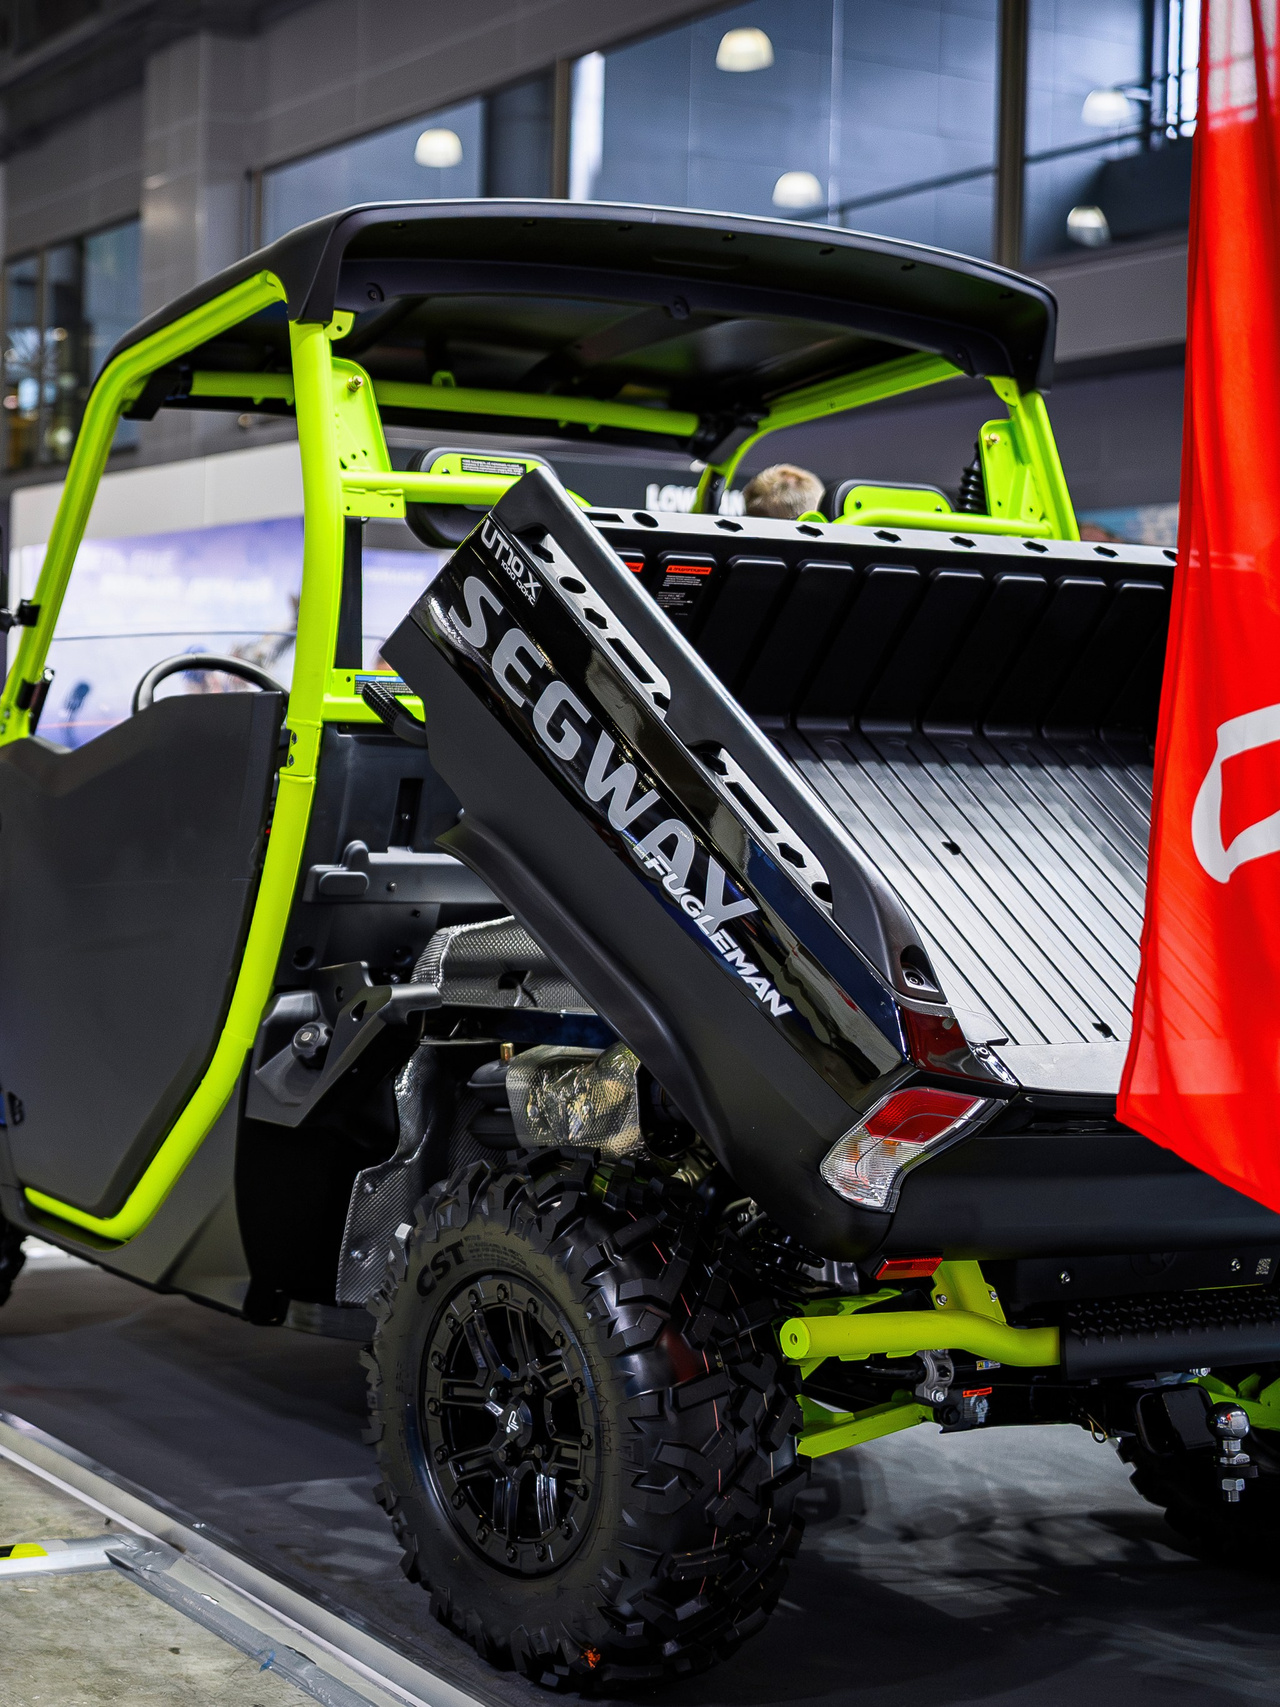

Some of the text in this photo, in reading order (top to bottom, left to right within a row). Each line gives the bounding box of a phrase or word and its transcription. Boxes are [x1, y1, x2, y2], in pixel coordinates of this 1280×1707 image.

[646, 483, 747, 516] LOWAN
[501, 560, 536, 608] 1000 DOHC
[448, 576, 759, 935] SEGWAY
[644, 855, 792, 1017] FUGLEMAN
[416, 1239, 465, 1297] CST
